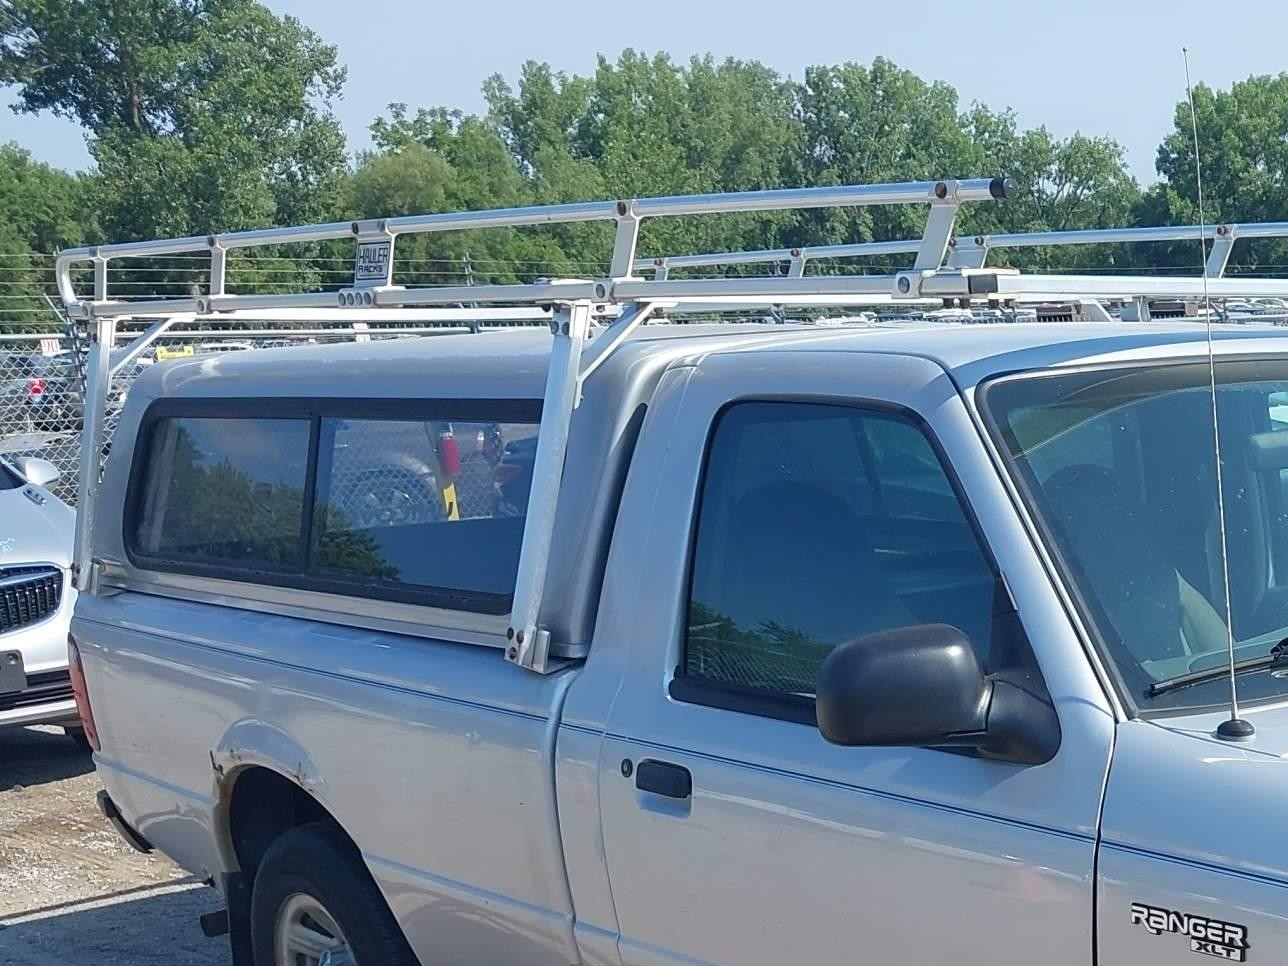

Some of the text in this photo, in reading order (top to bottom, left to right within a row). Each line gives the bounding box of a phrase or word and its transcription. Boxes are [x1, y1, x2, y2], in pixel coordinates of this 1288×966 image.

[358, 247, 389, 264] HAULER
[358, 264, 384, 273] RACKS
[1131, 902, 1250, 949] RANGER
[1195, 940, 1236, 958] XLT
